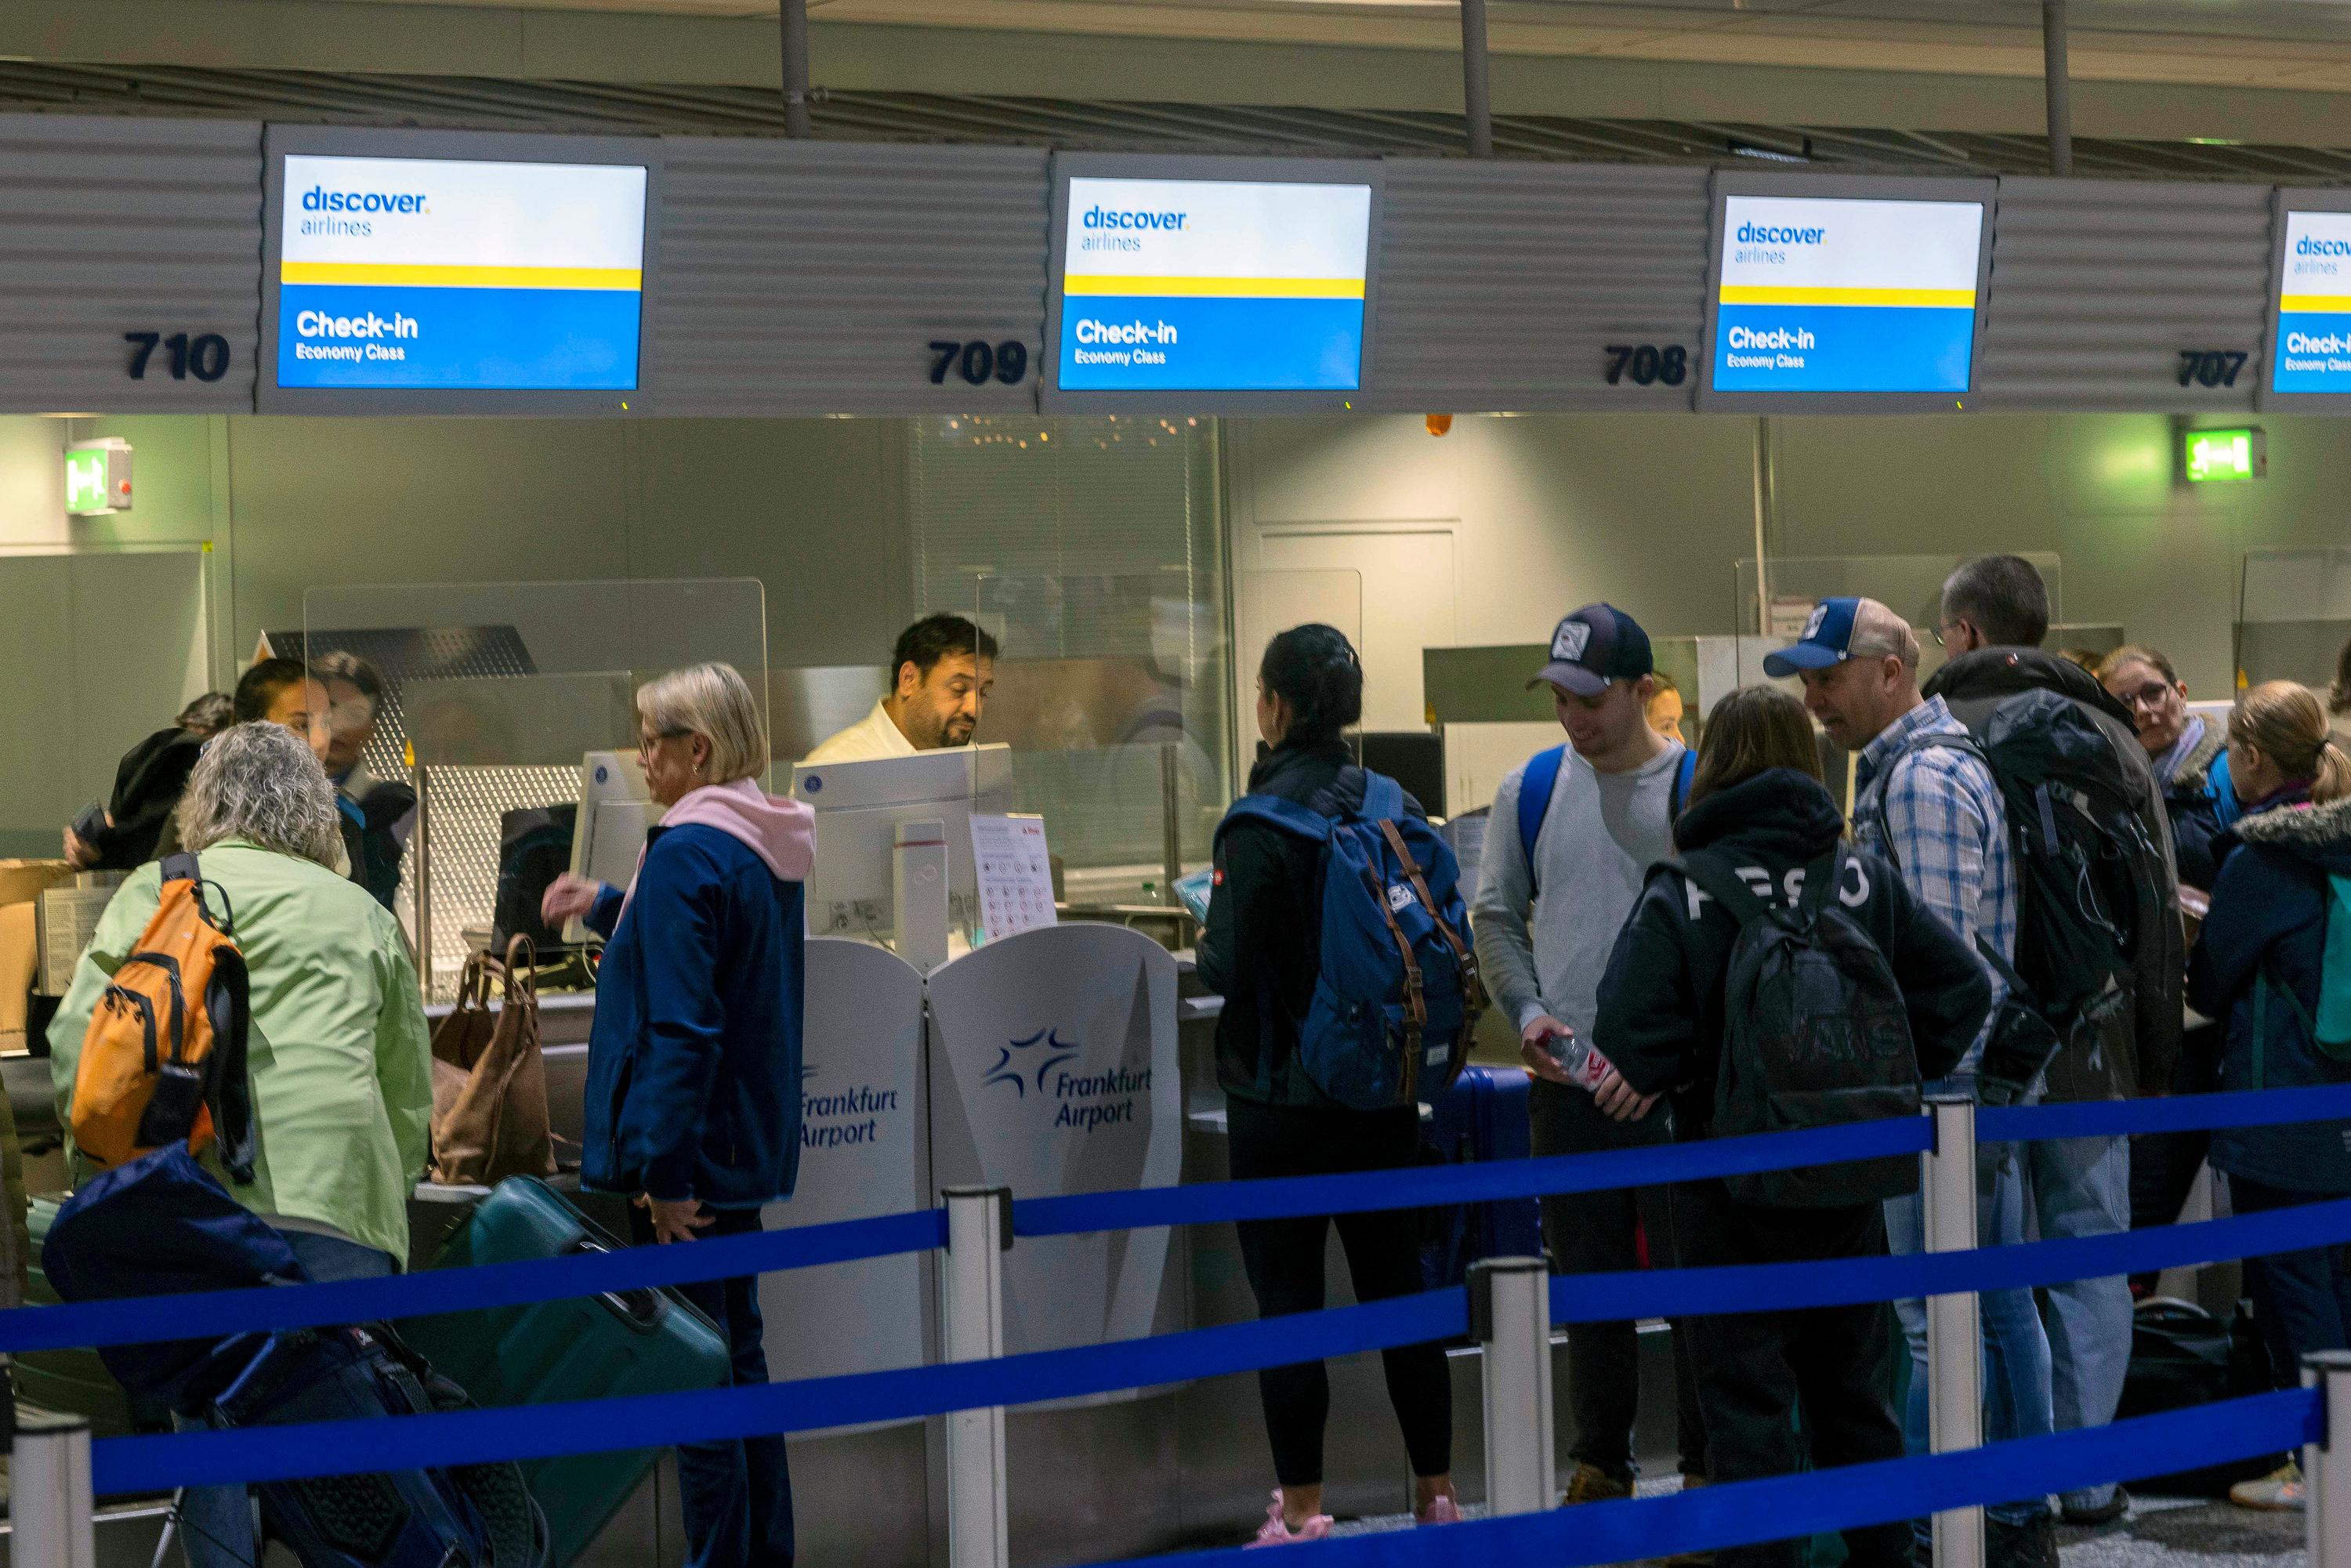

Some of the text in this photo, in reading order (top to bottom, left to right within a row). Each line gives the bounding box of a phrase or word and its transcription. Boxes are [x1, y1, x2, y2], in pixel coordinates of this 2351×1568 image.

[301, 215, 372, 237] airlines
[1081, 233, 1142, 252] airlines
[1734, 246, 1787, 265] airlines
[296, 310, 418, 339] Check-in
[1075, 318, 1178, 345] Check-in
[1728, 325, 1816, 350] Check-in
[125, 331, 230, 382] 710
[295, 342, 406, 364] Economy Class
[929, 339, 1028, 386] 709
[1074, 347, 1166, 368] Economy Class
[1603, 345, 1688, 386] 708
[1726, 353, 1805, 371] Economy Class
[2285, 357, 2327, 375] Economy
[2178, 349, 2248, 387] 707
[1056, 1065, 1152, 1098] Frankfurt
[1054, 1099, 1133, 1134] Airport
